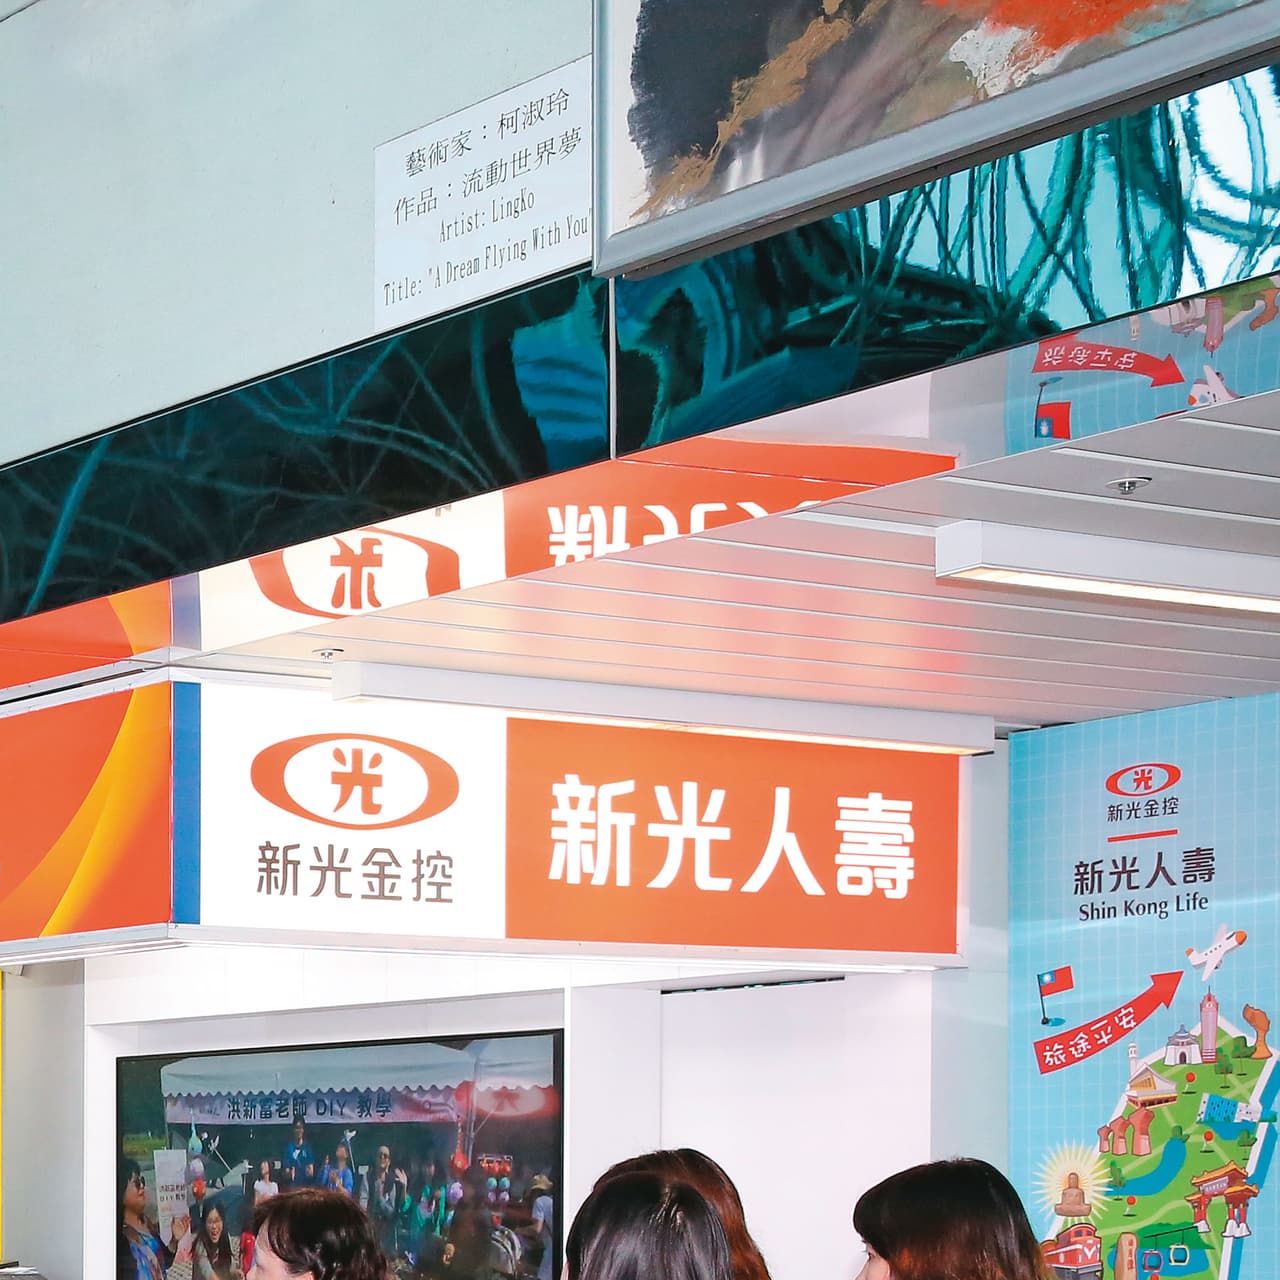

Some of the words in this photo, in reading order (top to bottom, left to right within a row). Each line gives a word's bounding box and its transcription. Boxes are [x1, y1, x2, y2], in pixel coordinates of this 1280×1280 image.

[439, 210, 486, 243] Artist:
[492, 187, 535, 223] LingKo
[383, 277, 422, 306] Title:
[446, 253, 480, 284] Dream
[485, 238, 527, 272] Flying
[533, 221, 561, 252] With
[547, 773, 915, 901] 新光人壽
[1106, 796, 1180, 823] 新光金控
[256, 840, 455, 905] 新光金控
[1073, 847, 1217, 897] 新光人壽
[1078, 901, 1118, 922] Shin
[1123, 898, 1169, 921] Kong
[1175, 892, 1209, 914] Life
[1042, 1005, 1138, 1067] 旅途平安
[316, 1098, 346, 1117] DIY
[356, 1097, 392, 1118] 教學
